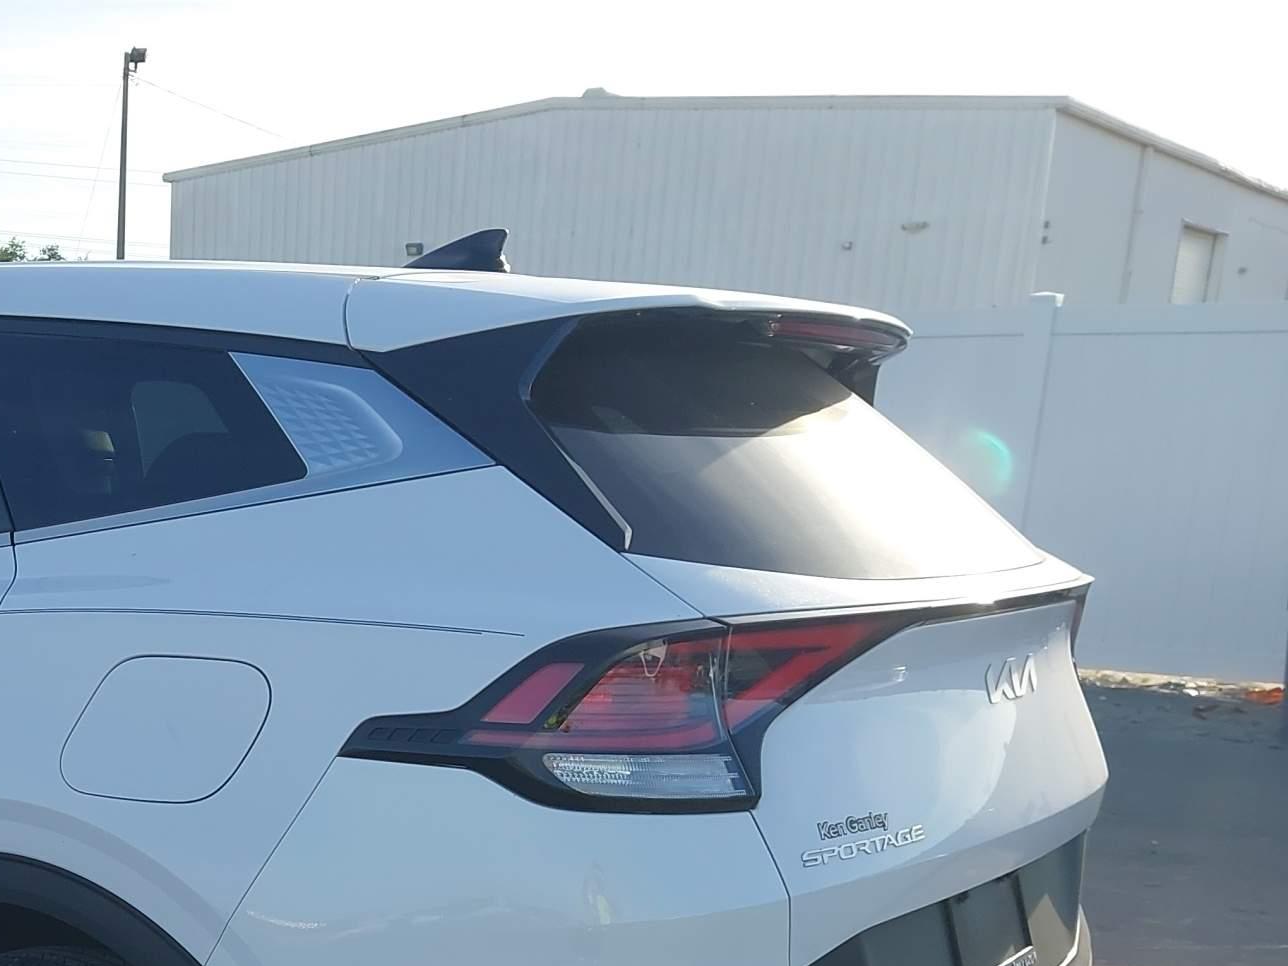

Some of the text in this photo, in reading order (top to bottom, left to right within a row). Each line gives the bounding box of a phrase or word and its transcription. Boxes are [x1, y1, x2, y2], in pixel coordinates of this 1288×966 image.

[985, 653, 1037, 704] KIA
[801, 824, 926, 868] SPORTAGE
[817, 812, 888, 840] Ken Ganley
